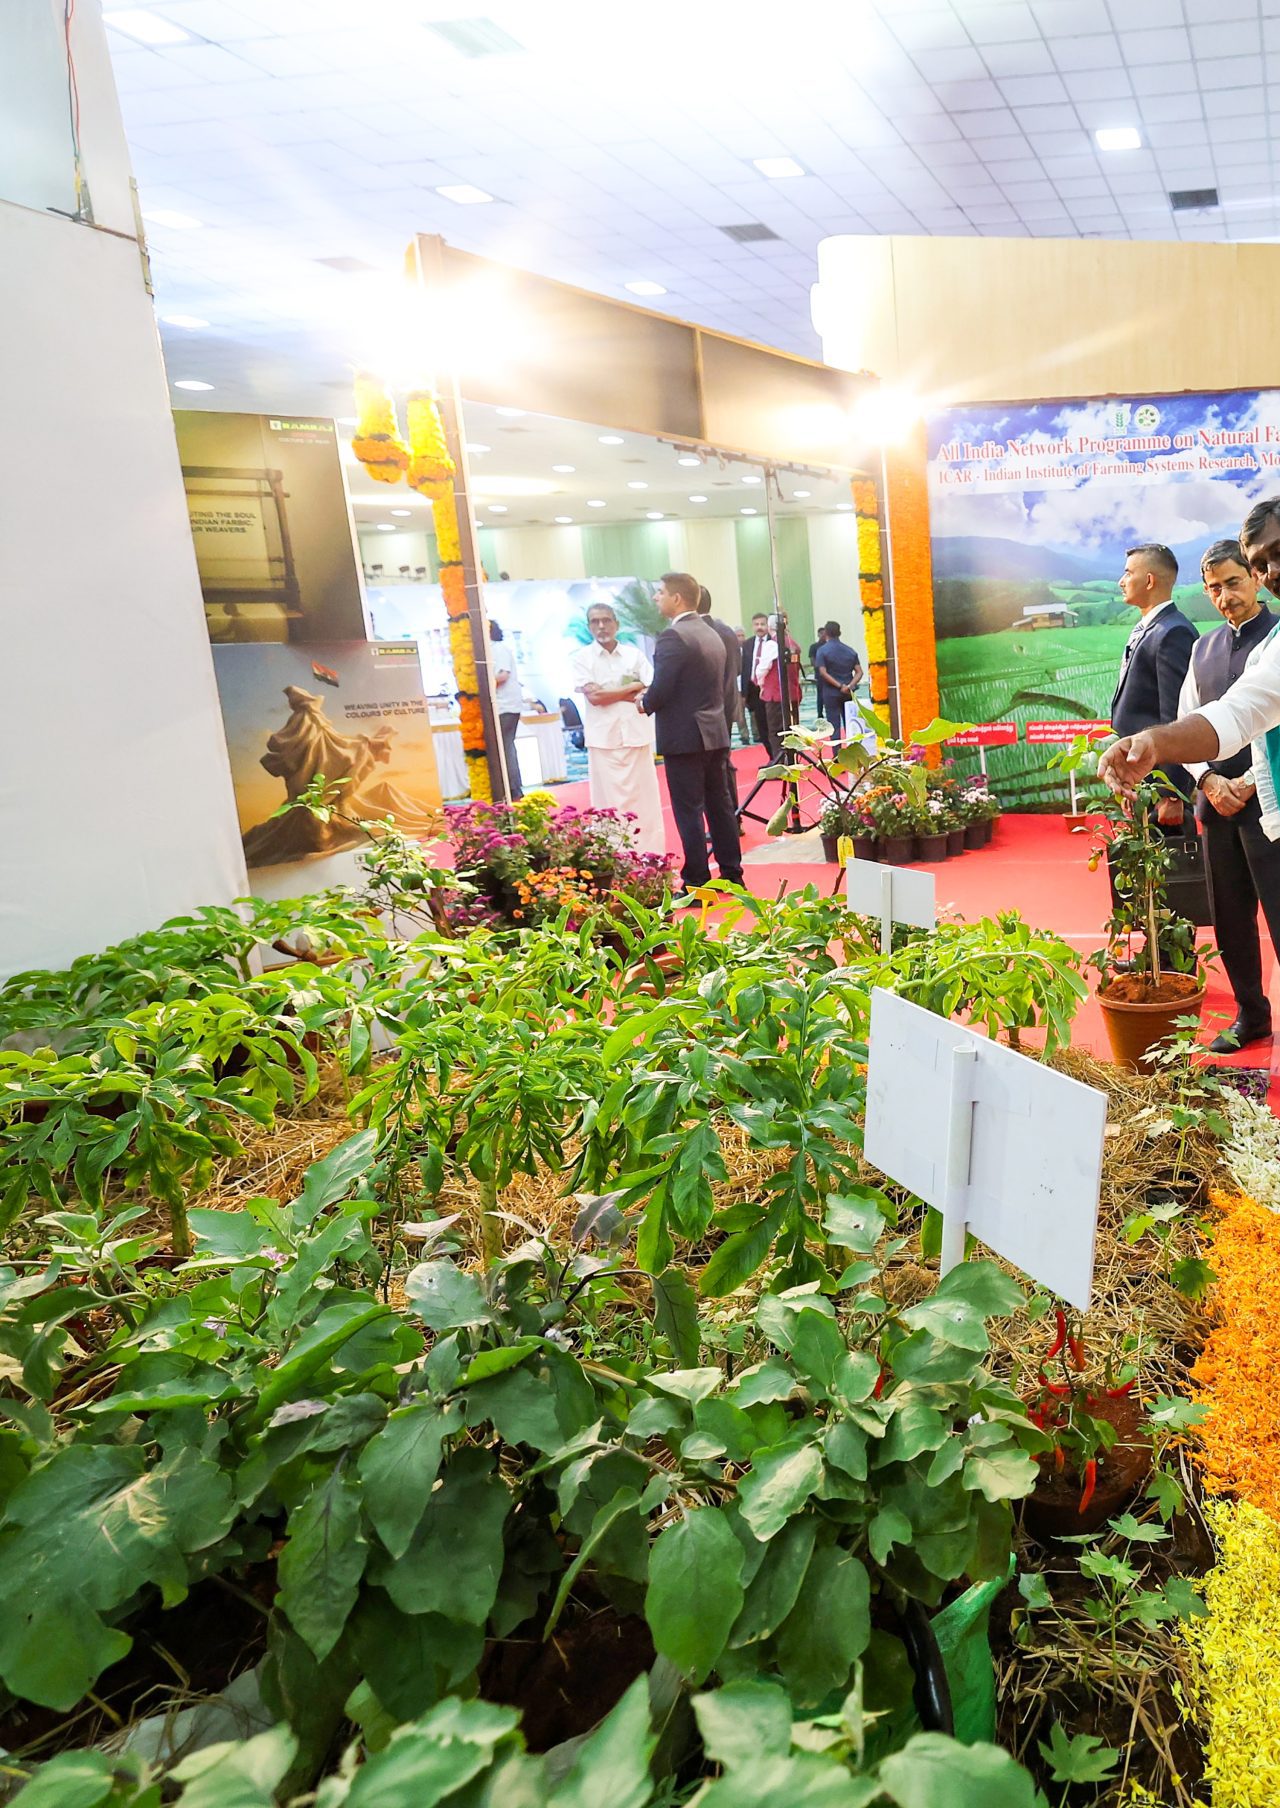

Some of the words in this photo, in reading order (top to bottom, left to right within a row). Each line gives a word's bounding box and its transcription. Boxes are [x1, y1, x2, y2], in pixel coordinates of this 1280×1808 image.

[938, 443, 959, 461] All
[964, 441, 1004, 459] India
[1007, 437, 1073, 457] Network
[1079, 435, 1170, 454] Programme
[1174, 435, 1193, 448] on
[1199, 427, 1260, 446] Natural
[939, 470, 972, 484] ICAR
[984, 468, 1022, 481] Indian
[1026, 465, 1073, 479] Institute
[1077, 463, 1089, 476] of
[1093, 460, 1143, 476] Farming
[1146, 458, 1194, 475] Systems
[1199, 454, 1257, 470] Research,
[344, 703, 378, 711] WEAVING
[345, 710, 381, 719] COLOURS
